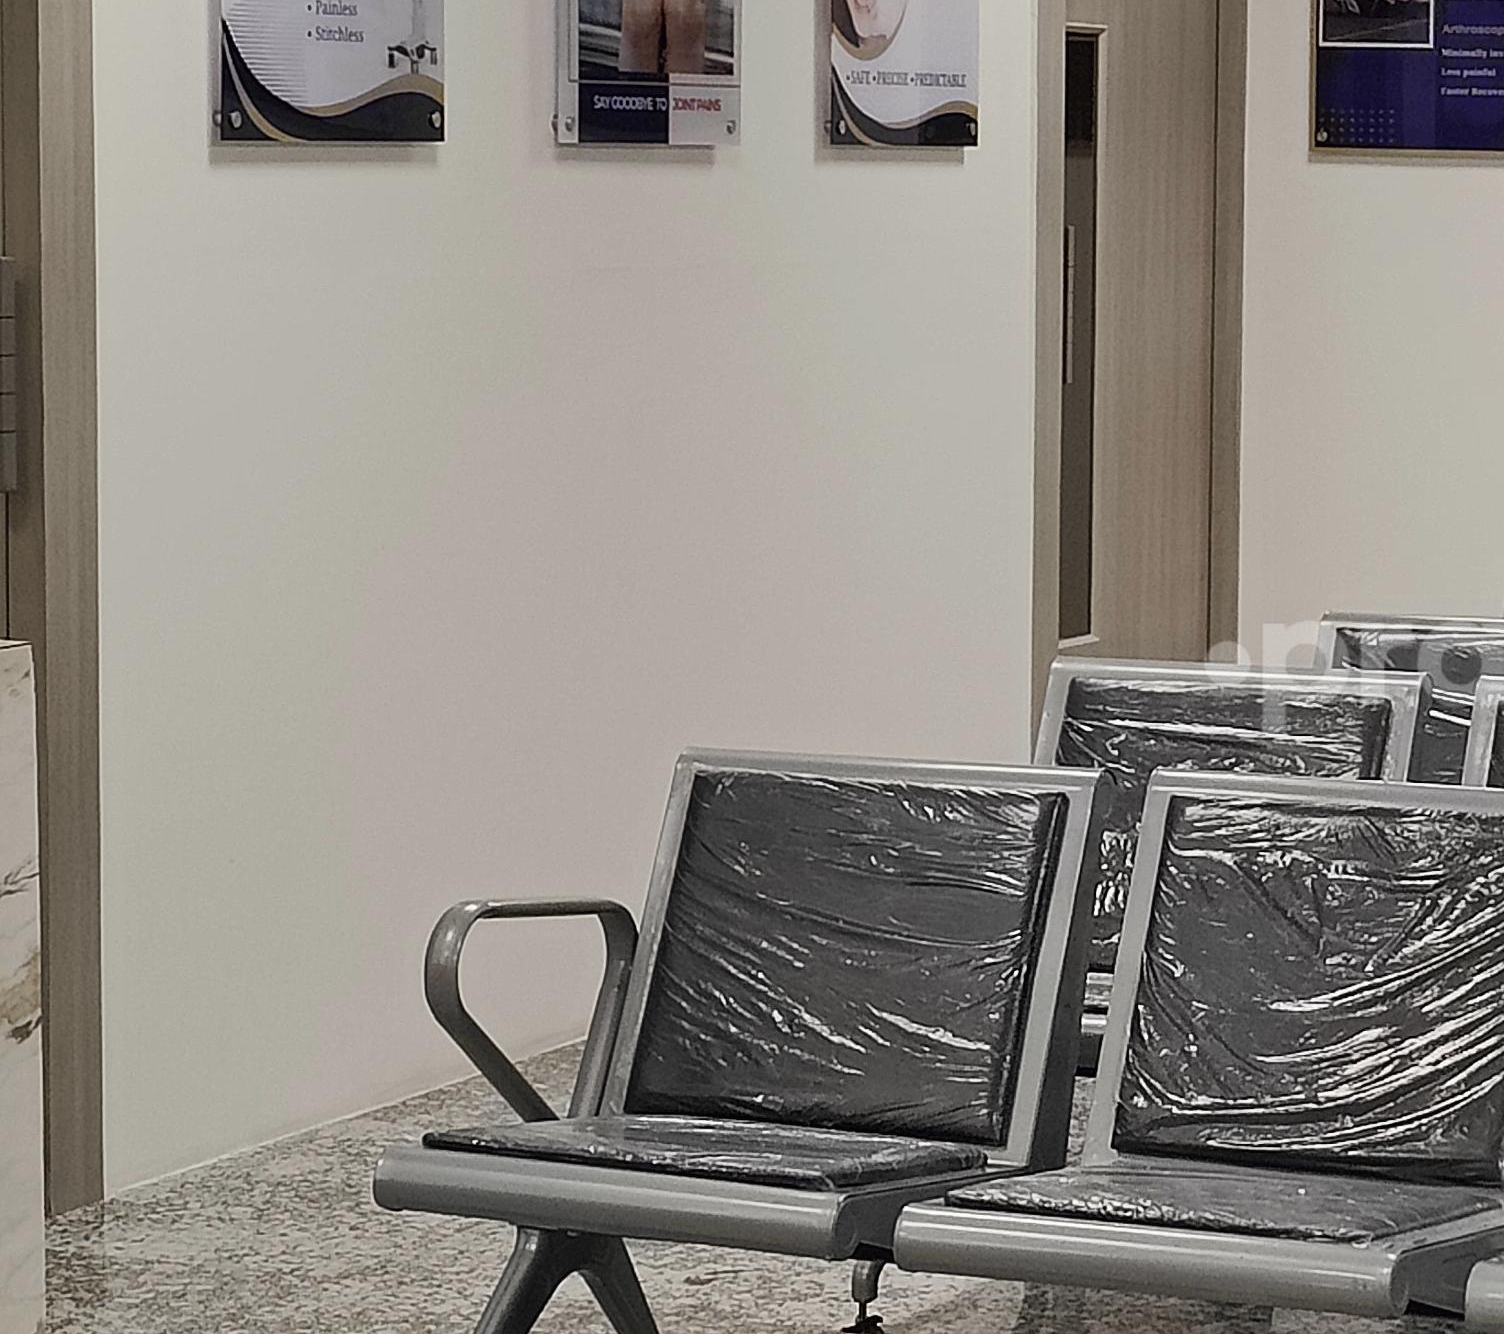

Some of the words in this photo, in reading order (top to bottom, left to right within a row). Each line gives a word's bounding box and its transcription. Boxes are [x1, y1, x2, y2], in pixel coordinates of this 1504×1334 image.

[316, 0, 358, 16] Painless
[316, 26, 364, 43] Stitchless
[593, 95, 610, 109] SAY
[611, 96, 653, 110] GOODBYE
[655, 97, 667, 111] TO
